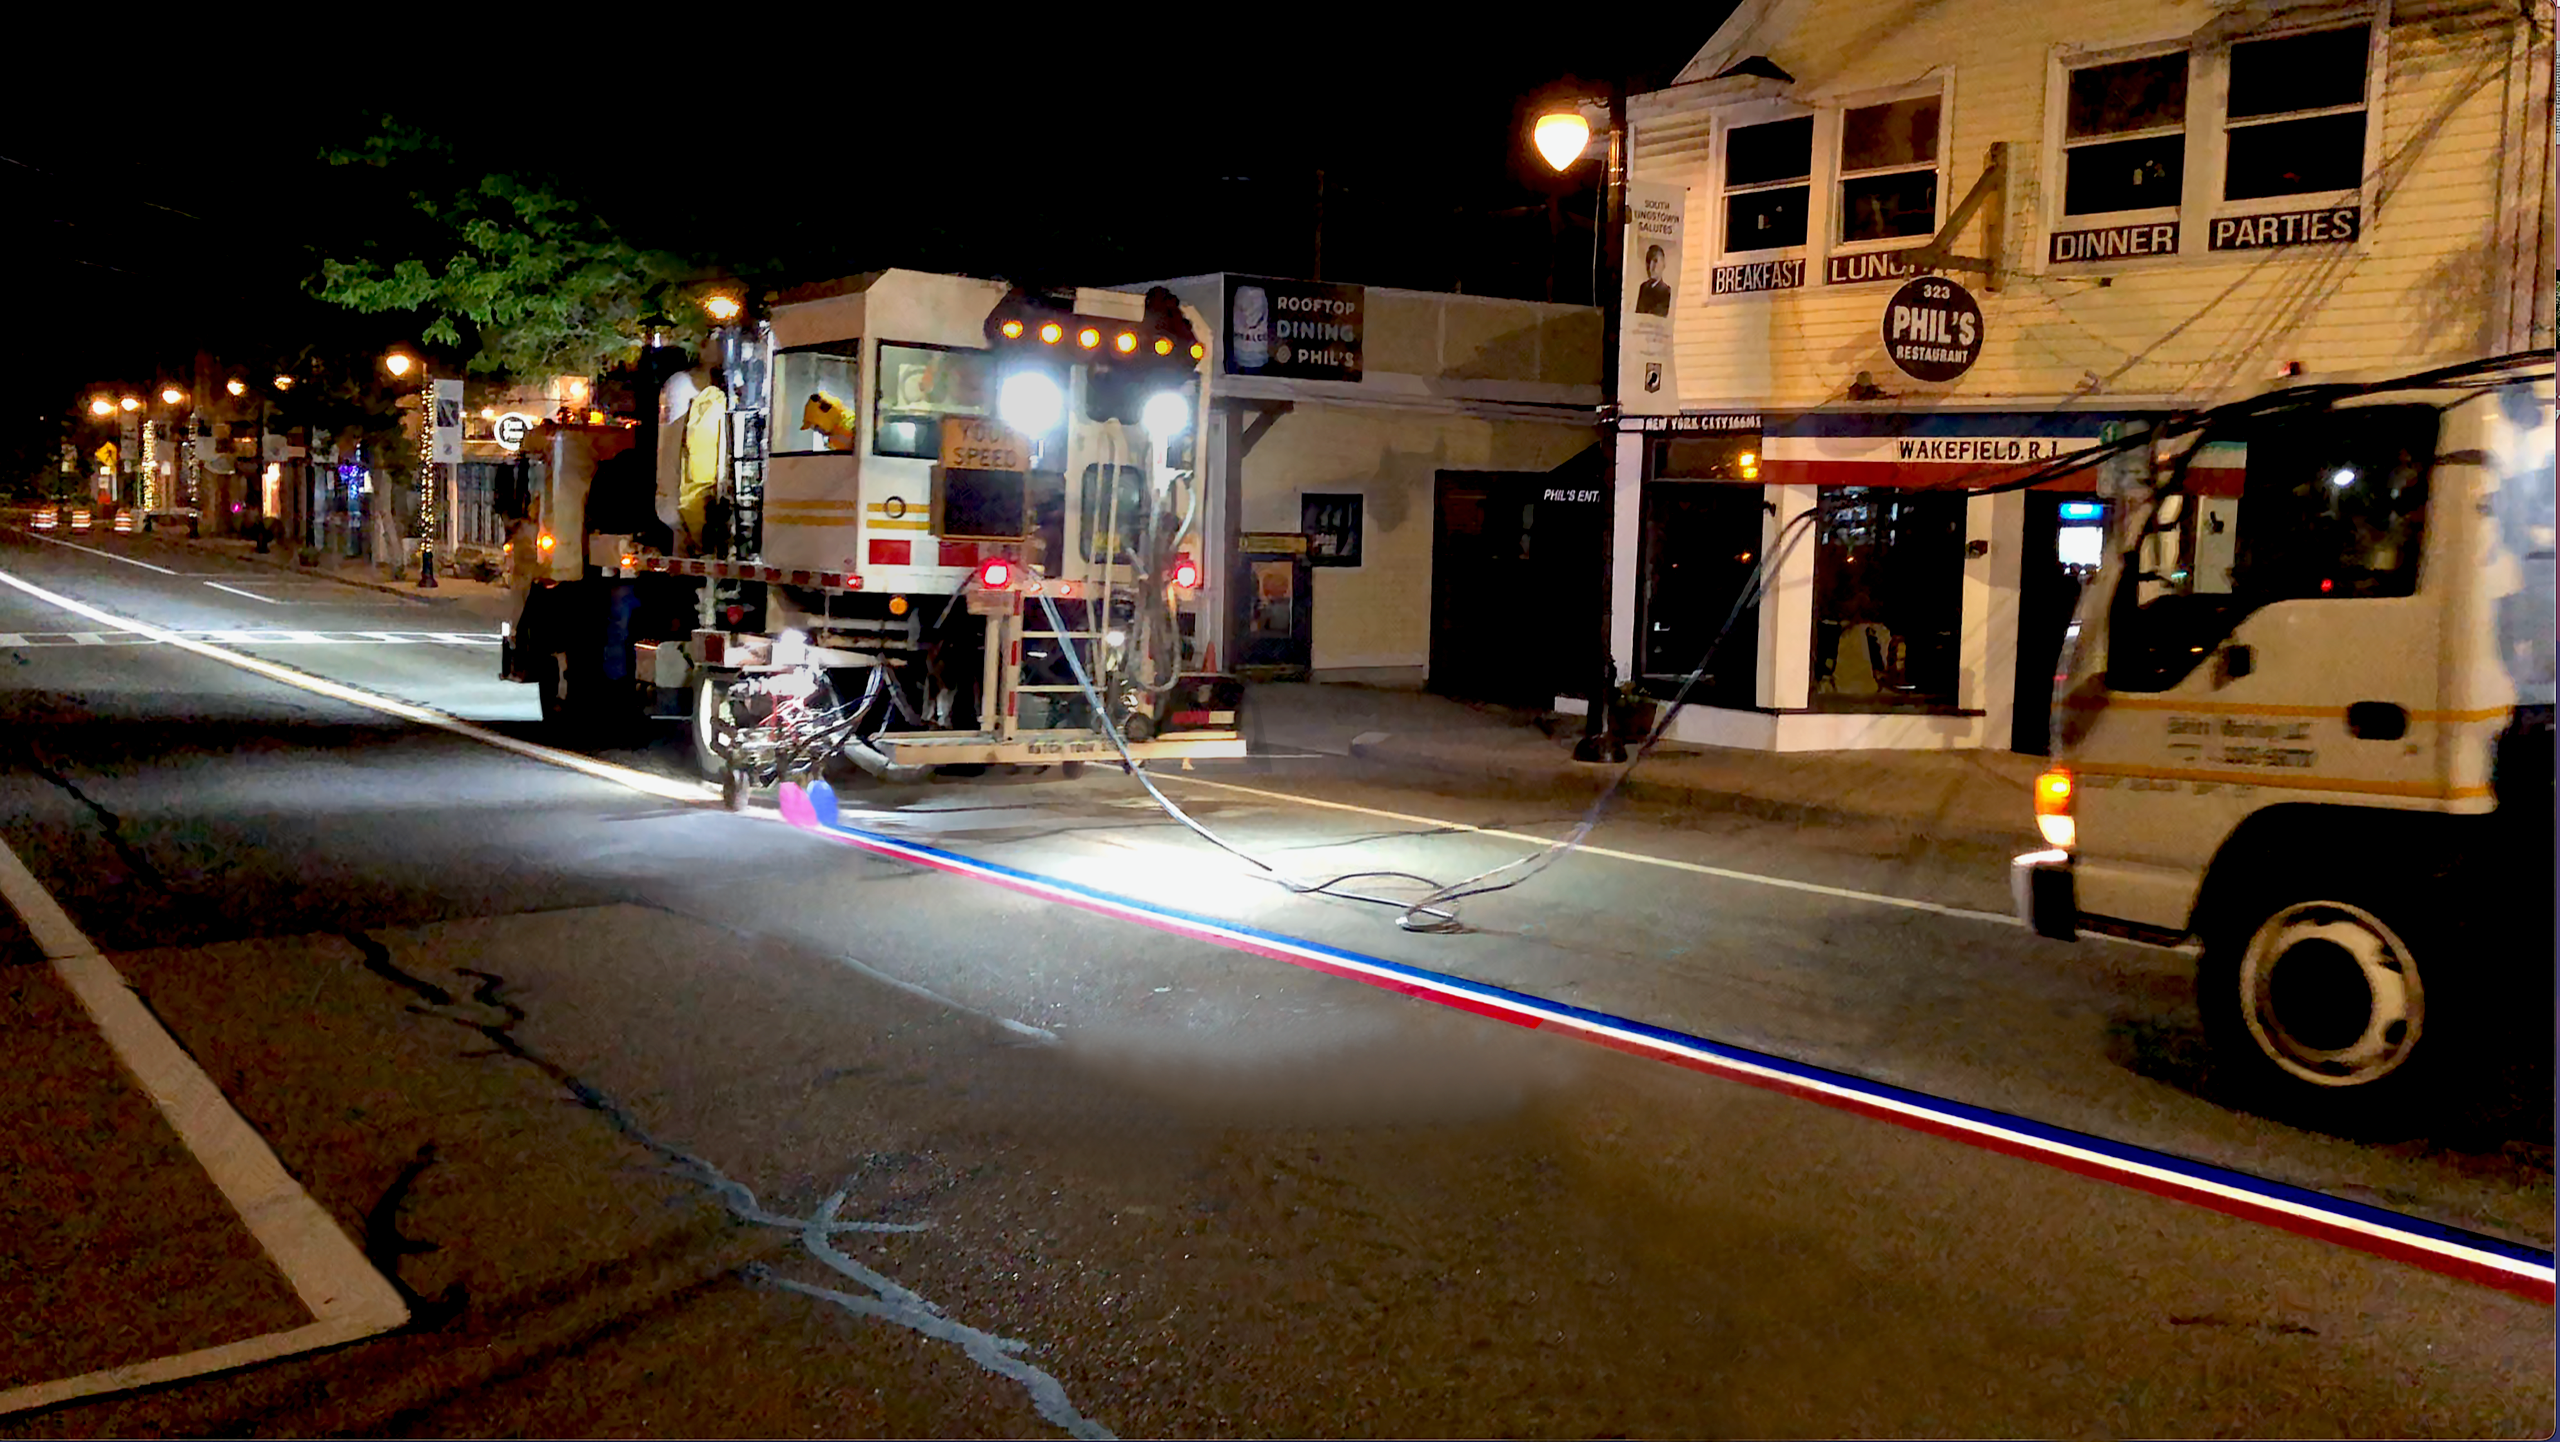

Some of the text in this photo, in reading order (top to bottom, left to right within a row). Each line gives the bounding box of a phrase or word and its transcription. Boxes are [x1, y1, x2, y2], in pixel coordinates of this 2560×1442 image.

[1644, 199, 1670, 211] SOUTH
[1638, 221, 1673, 235] SALUTES
[2216, 210, 2353, 248] PARTIES
[2056, 225, 2174, 261] DINNER
[1715, 259, 1803, 294] BREAKFAST
[1923, 284, 1951, 300] 323
[1277, 296, 1355, 316] ROOFTOP
[1276, 319, 1355, 342] DINING
[1893, 305, 1976, 347] PHIL'S
[1298, 348, 1354, 368] PHIL'S
[1896, 344, 1969, 364] RESTAURANT
[1645, 416, 1667, 431] NEW
[1671, 416, 1699, 431] YORK
[1701, 415, 1728, 431] CITY
[952, 446, 1017, 469] SPEED
[1544, 488, 1576, 503] PHIL'S
